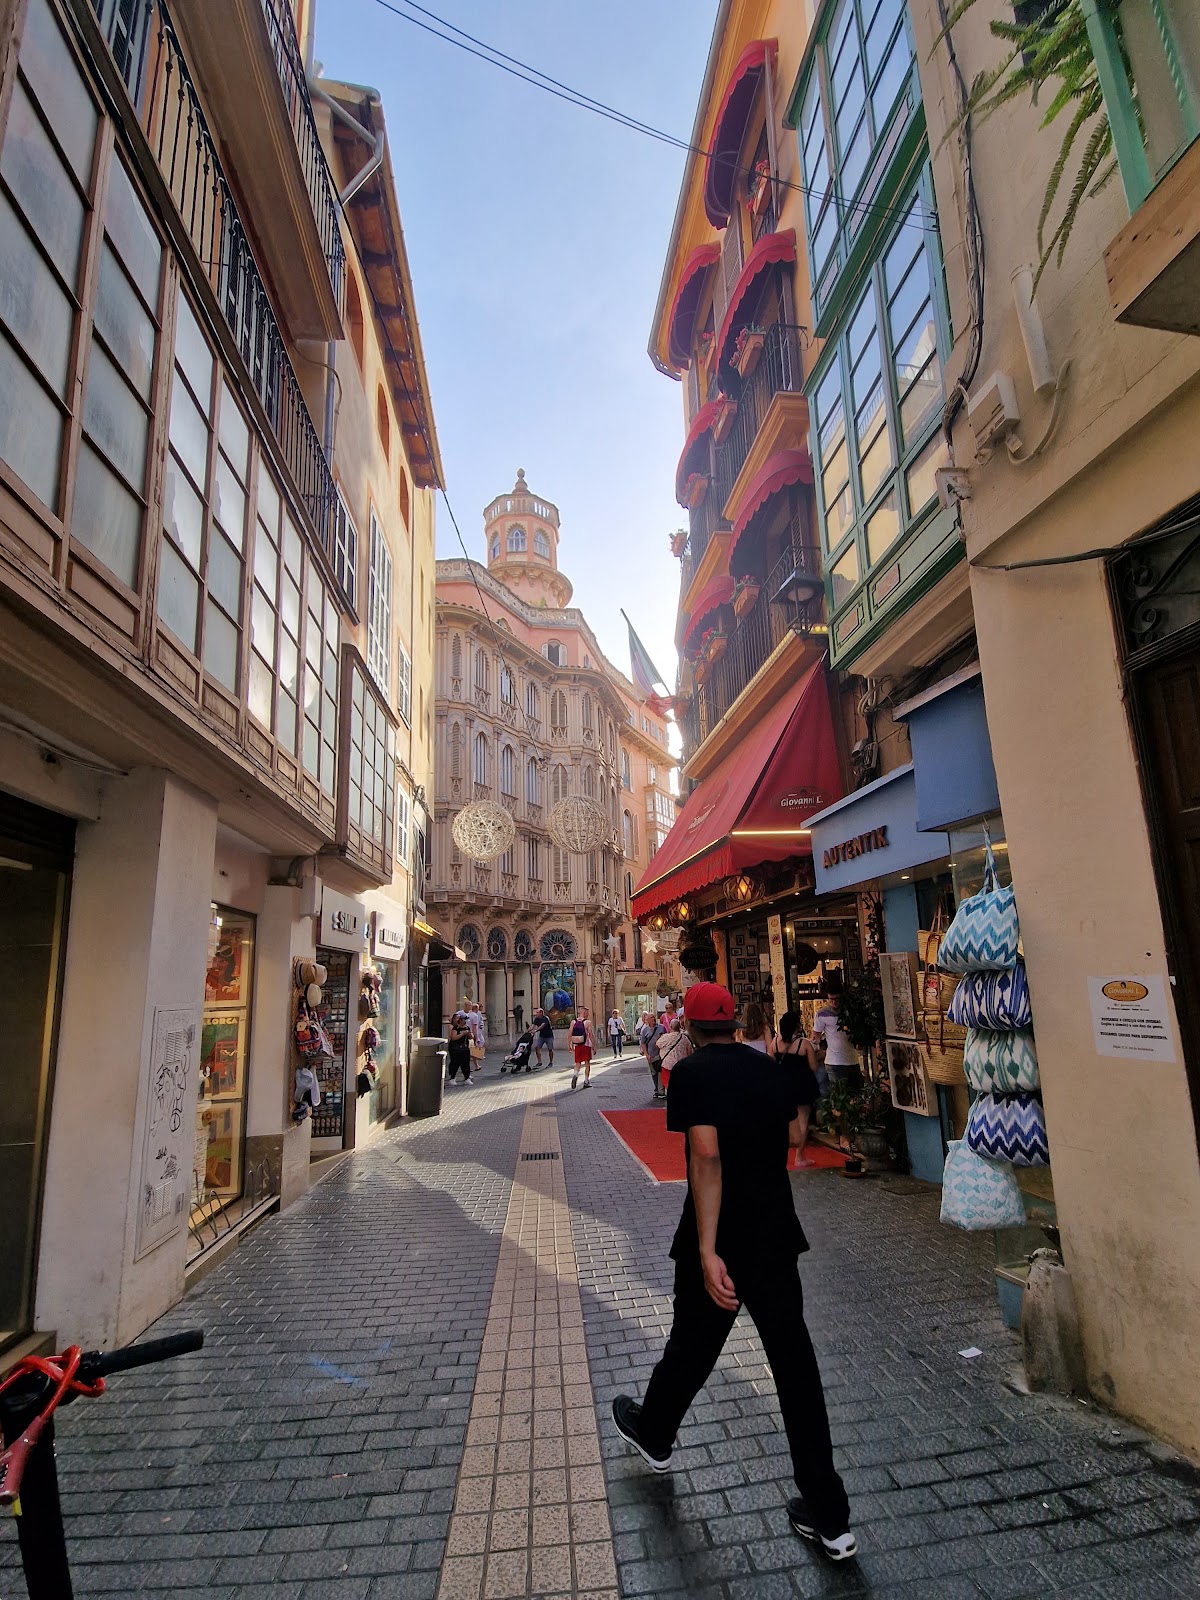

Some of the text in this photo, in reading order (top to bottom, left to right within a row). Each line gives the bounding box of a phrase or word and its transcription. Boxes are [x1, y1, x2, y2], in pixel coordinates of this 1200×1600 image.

[780, 795, 824, 807] Giovanni L.
[823, 825, 889, 868] AUTENTIK
